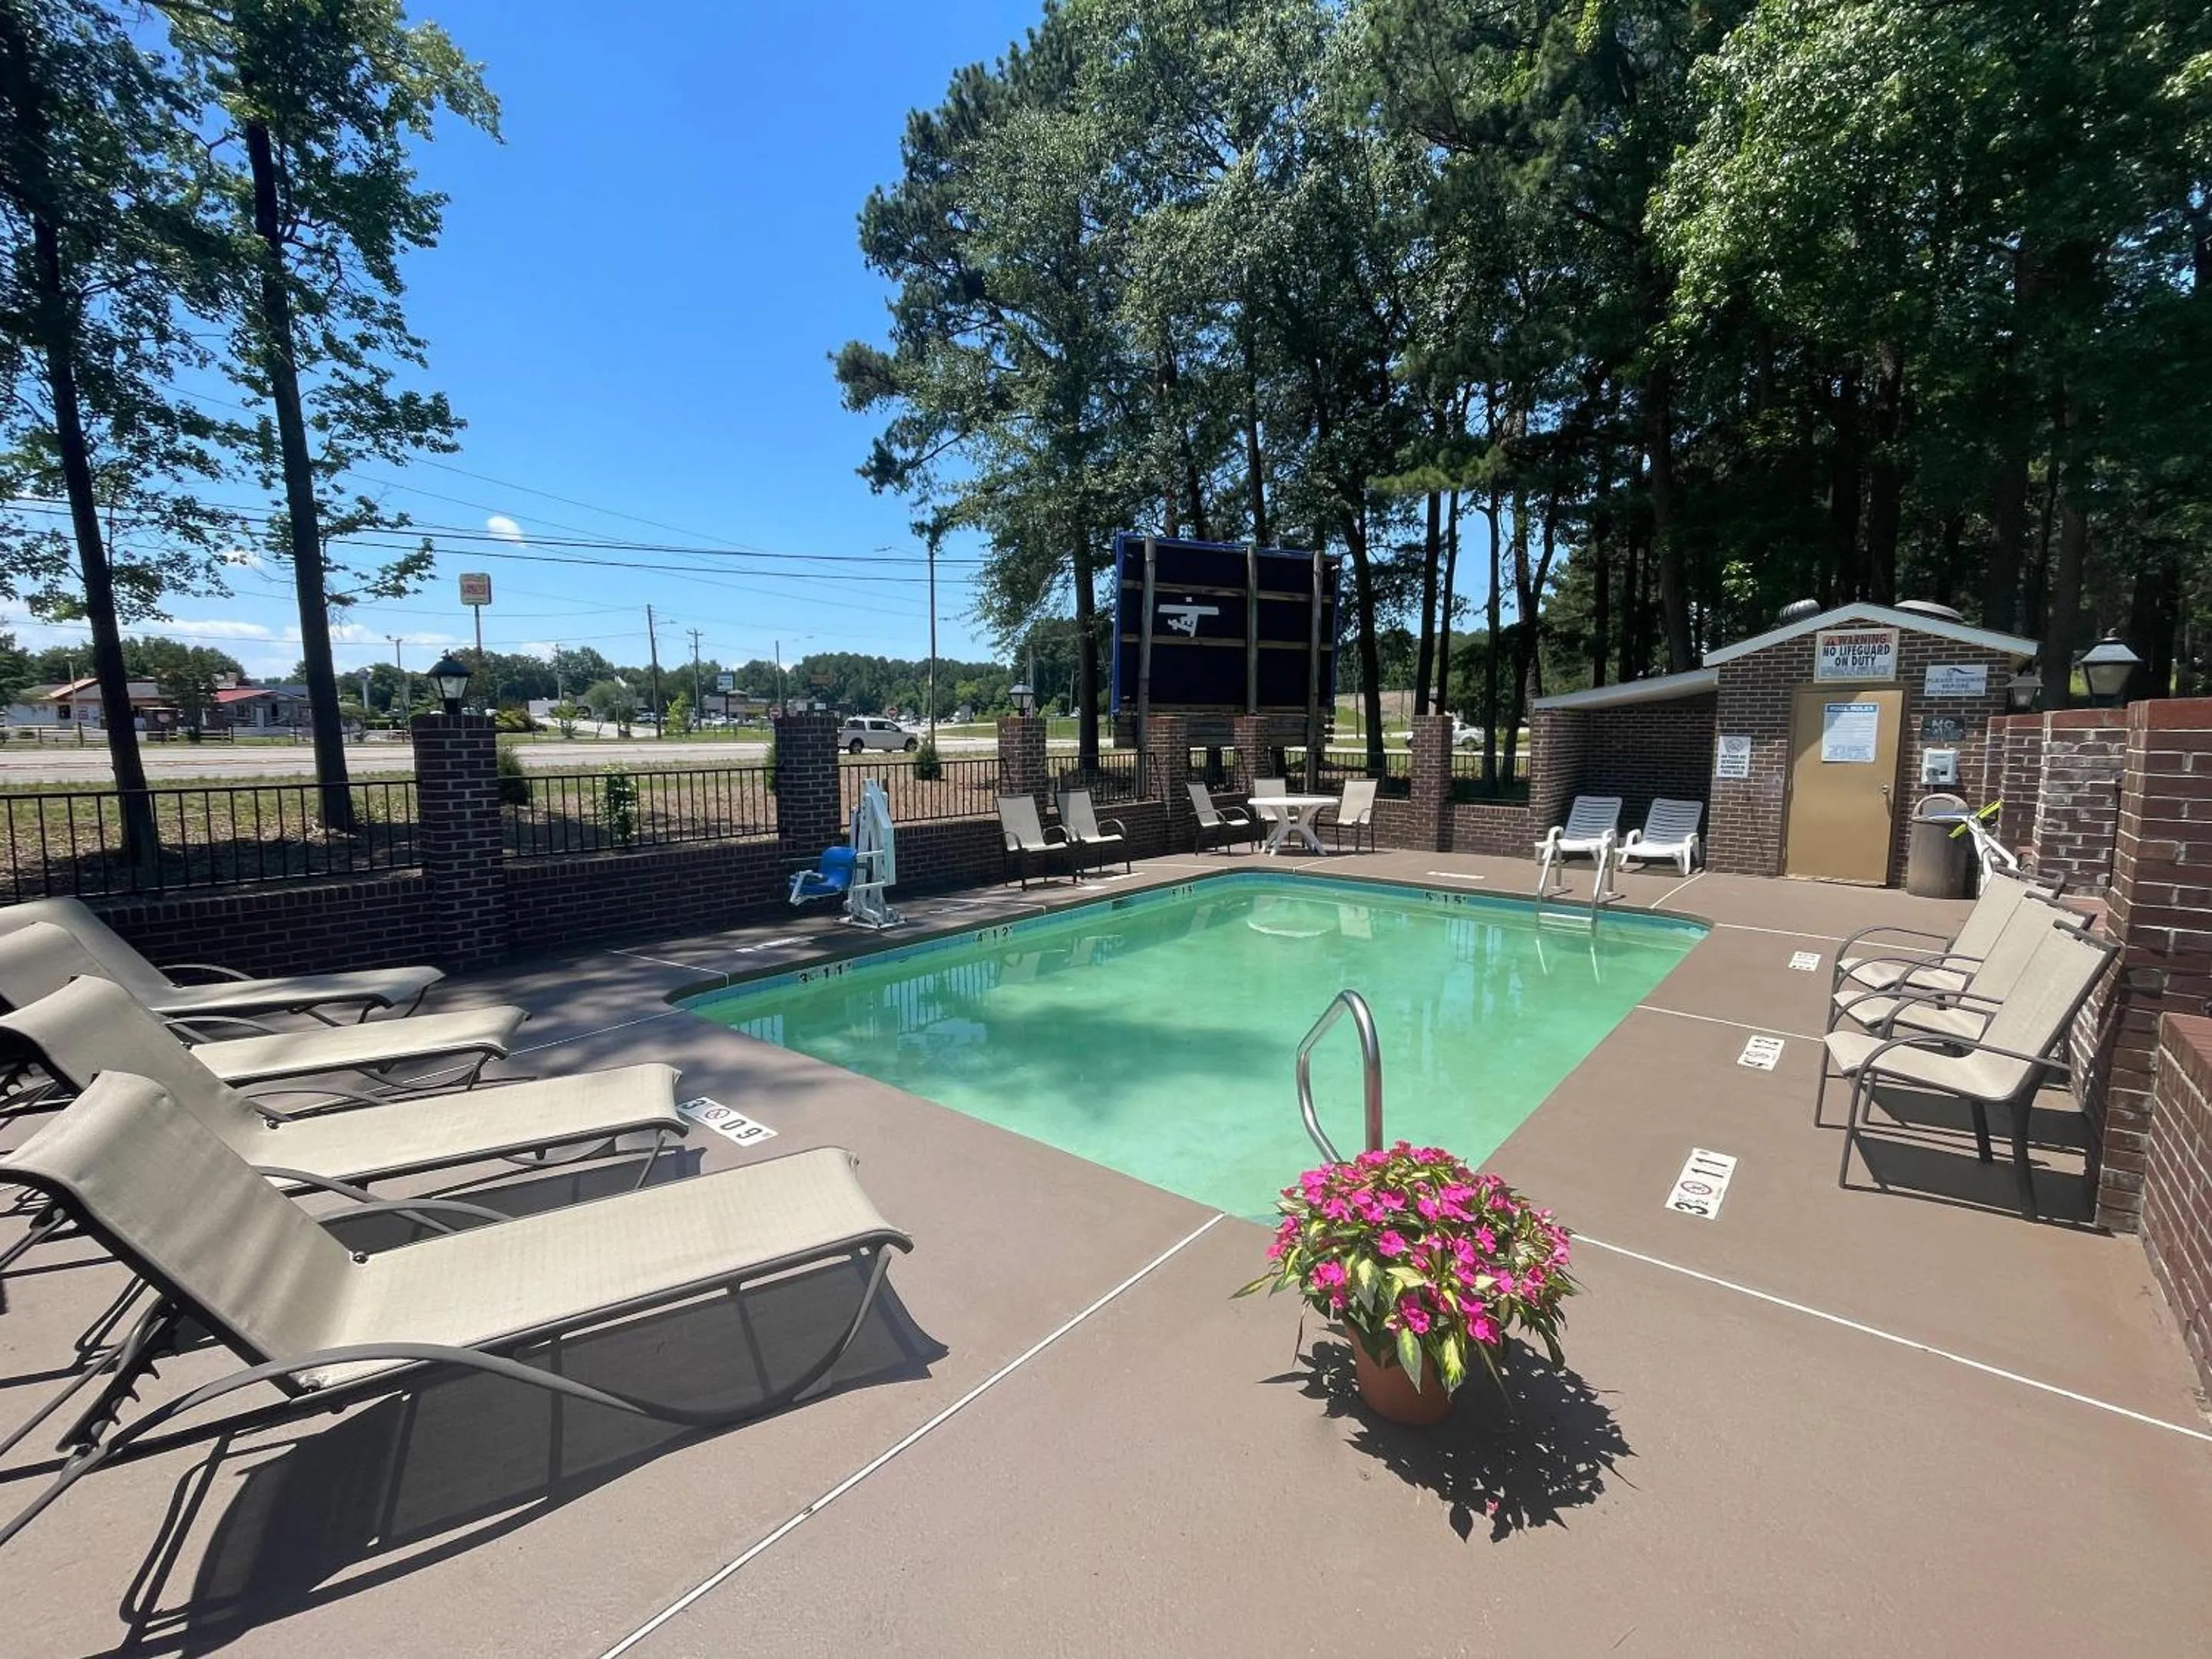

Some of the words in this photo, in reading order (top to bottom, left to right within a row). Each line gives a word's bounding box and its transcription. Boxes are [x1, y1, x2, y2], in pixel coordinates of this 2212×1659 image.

[1839, 634, 1887, 645] WARNING
[1823, 647, 1836, 657] NO
[1839, 644, 1890, 656] LIFEGUARD
[1835, 657, 1849, 667] ON
[1852, 655, 1877, 667] DUTY
[1674, 1201, 1709, 1215] 3
